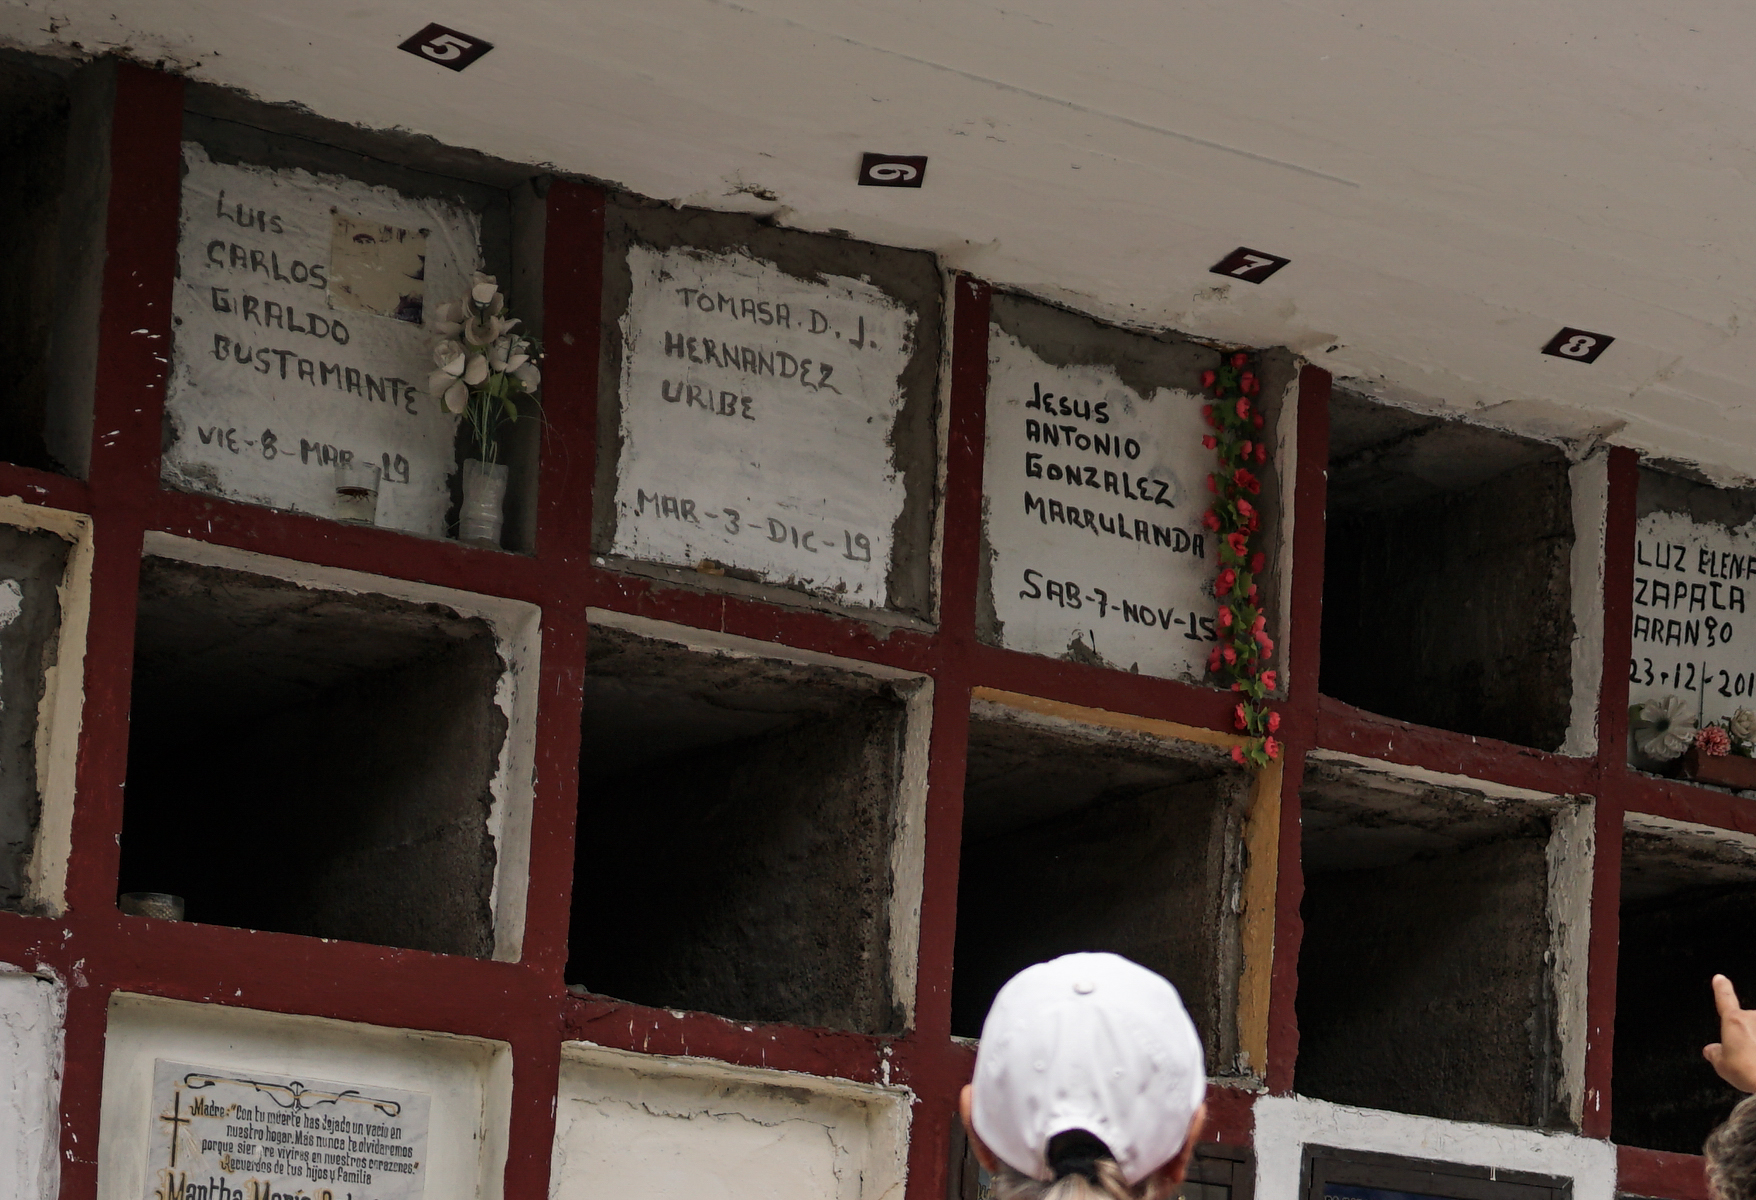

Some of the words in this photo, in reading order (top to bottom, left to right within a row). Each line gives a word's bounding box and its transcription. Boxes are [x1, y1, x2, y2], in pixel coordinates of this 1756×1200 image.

[420, 33, 471, 61] 5
[217, 189, 283, 235] LUIS
[206, 240, 329, 292] CARLOS
[1231, 253, 1275, 275] 7
[210, 286, 350, 346] GIRALDO
[663, 330, 843, 396] HERNANDEZ
[1559, 335, 1597, 358] 8
[213, 334, 419, 416] BUSTAMANTE
[661, 379, 757, 422] URIBE
[1025, 382, 1110, 425] JESUS
[1025, 418, 1142, 461] ANTONIO
[1025, 452, 1176, 509] GONZALEZ
[1024, 491, 1206, 560] MARRULANDA
[1637, 540, 1687, 573] LUZ
[1634, 577, 1745, 614] ZAPATA
[226, 1121, 264, 1143] nuestro
